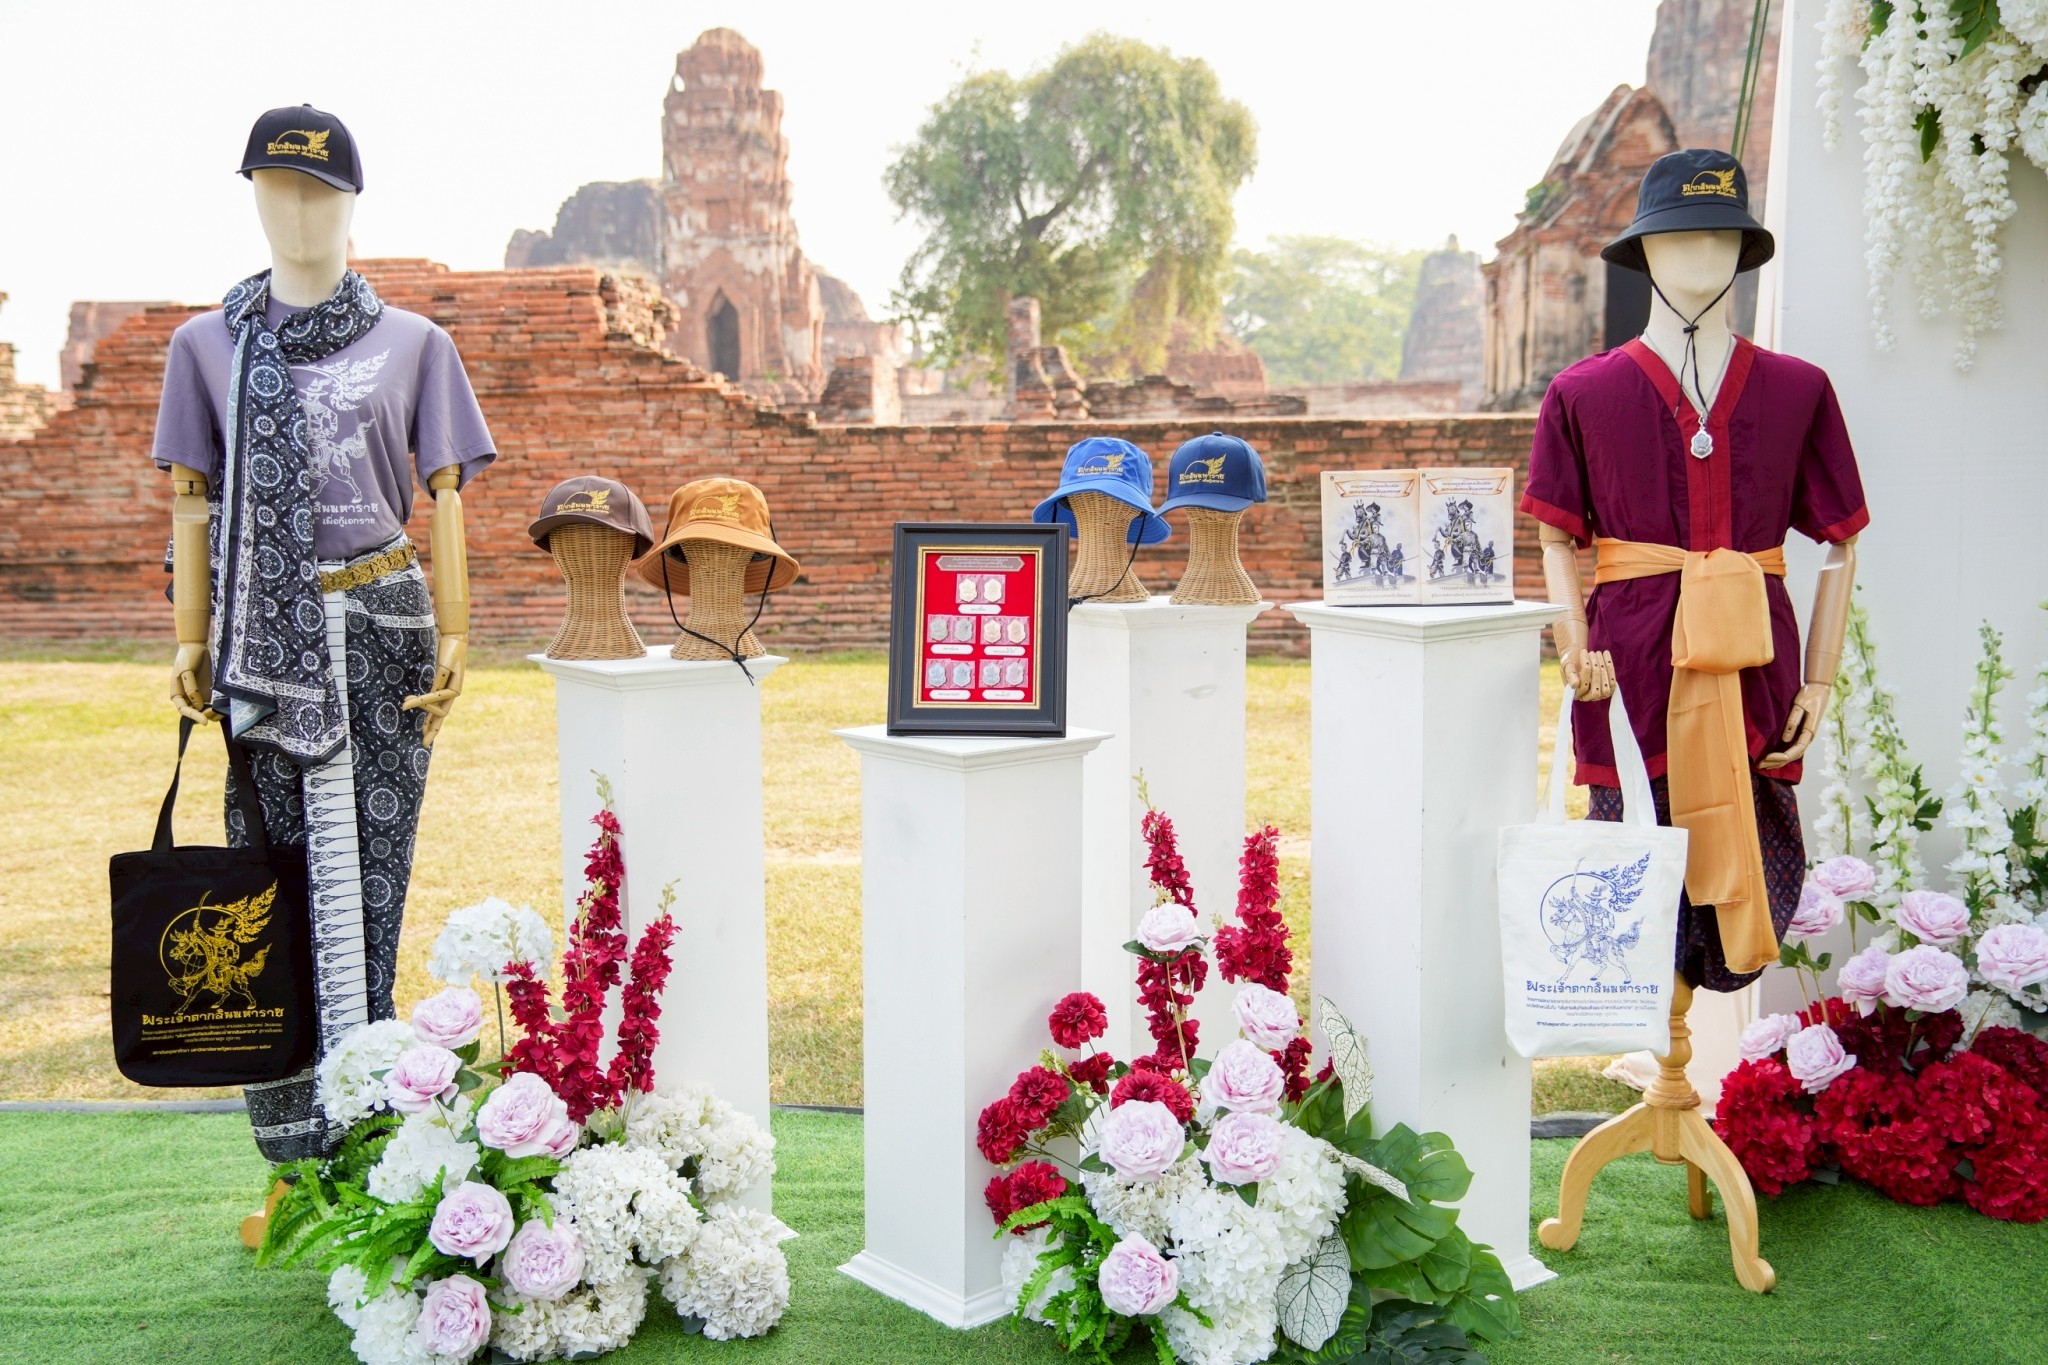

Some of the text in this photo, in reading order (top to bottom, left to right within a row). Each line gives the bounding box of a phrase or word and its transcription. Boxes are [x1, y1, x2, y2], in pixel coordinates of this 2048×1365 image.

[1526, 980, 1659, 995] พระเจ้าตากสินมหาราช
[142, 1007, 284, 1026] พระเจ้าตากสินมหาราช
